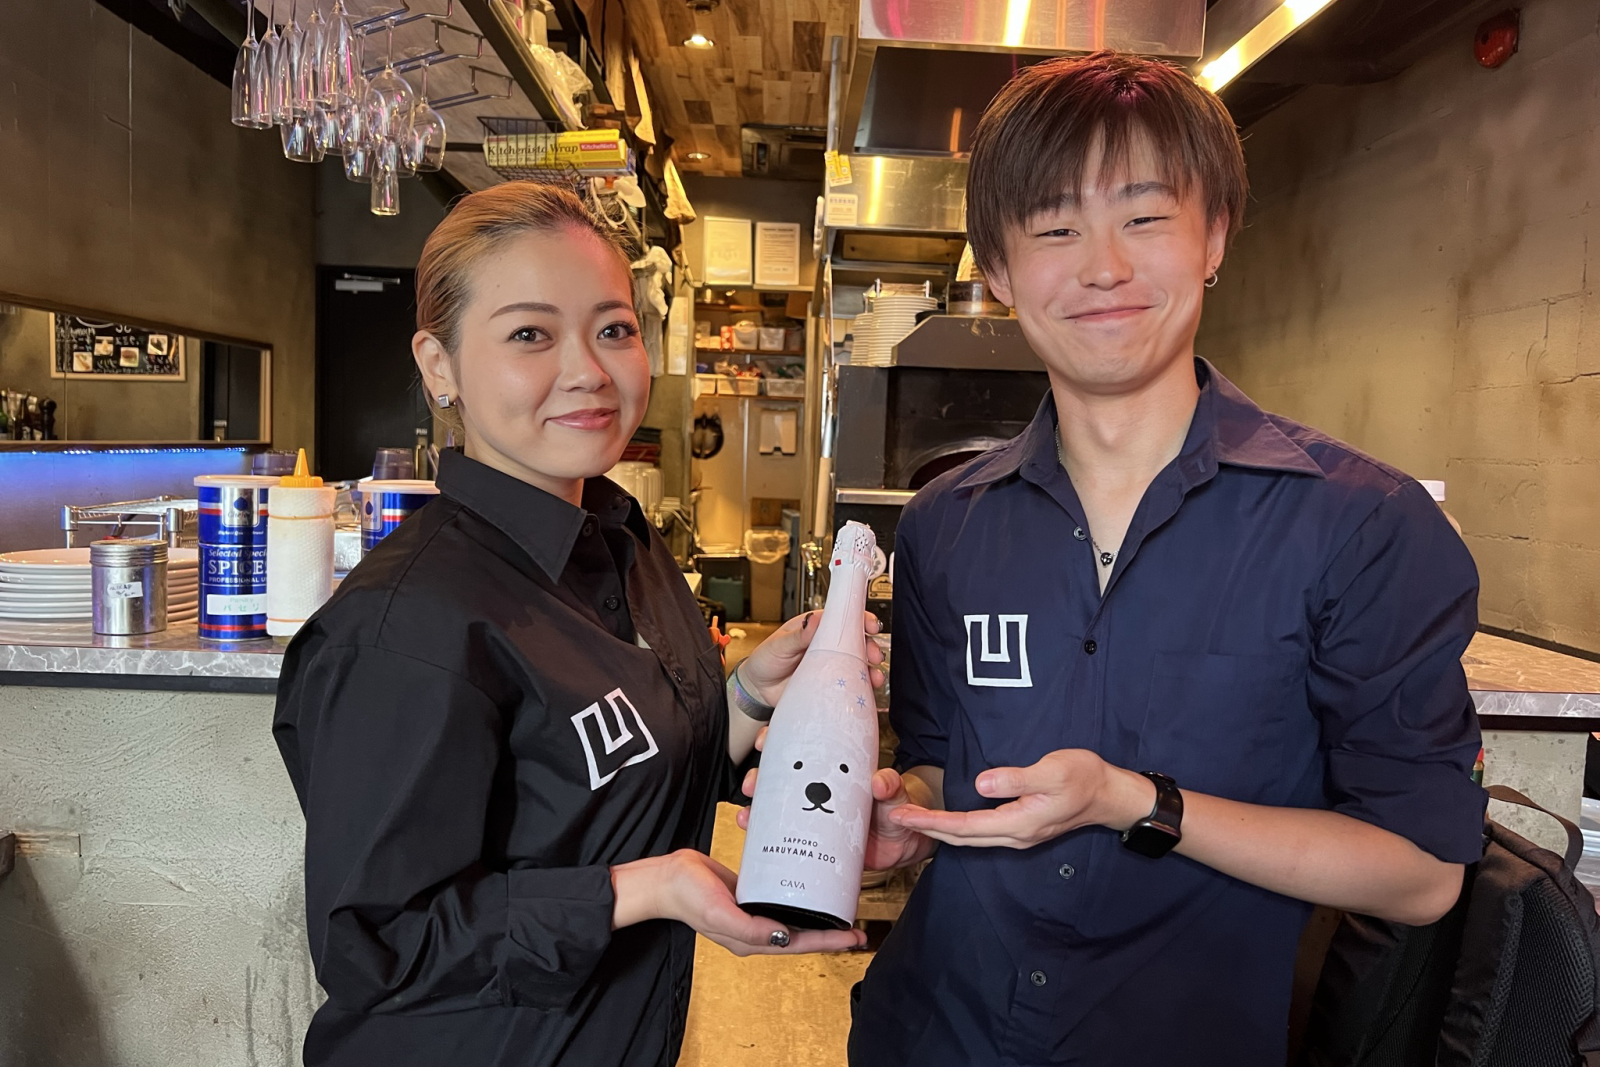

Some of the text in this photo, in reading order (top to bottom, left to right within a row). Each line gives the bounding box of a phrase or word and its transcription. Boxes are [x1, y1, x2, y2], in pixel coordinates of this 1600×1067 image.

[488, 143, 578, 155] Ktchenista Wrap
[208, 559, 267, 576] SPICE
[783, 836, 818, 848] SAPPORO
[762, 845, 836, 864] MARUYAMA ZOO
[780, 879, 806, 890] CAVA
